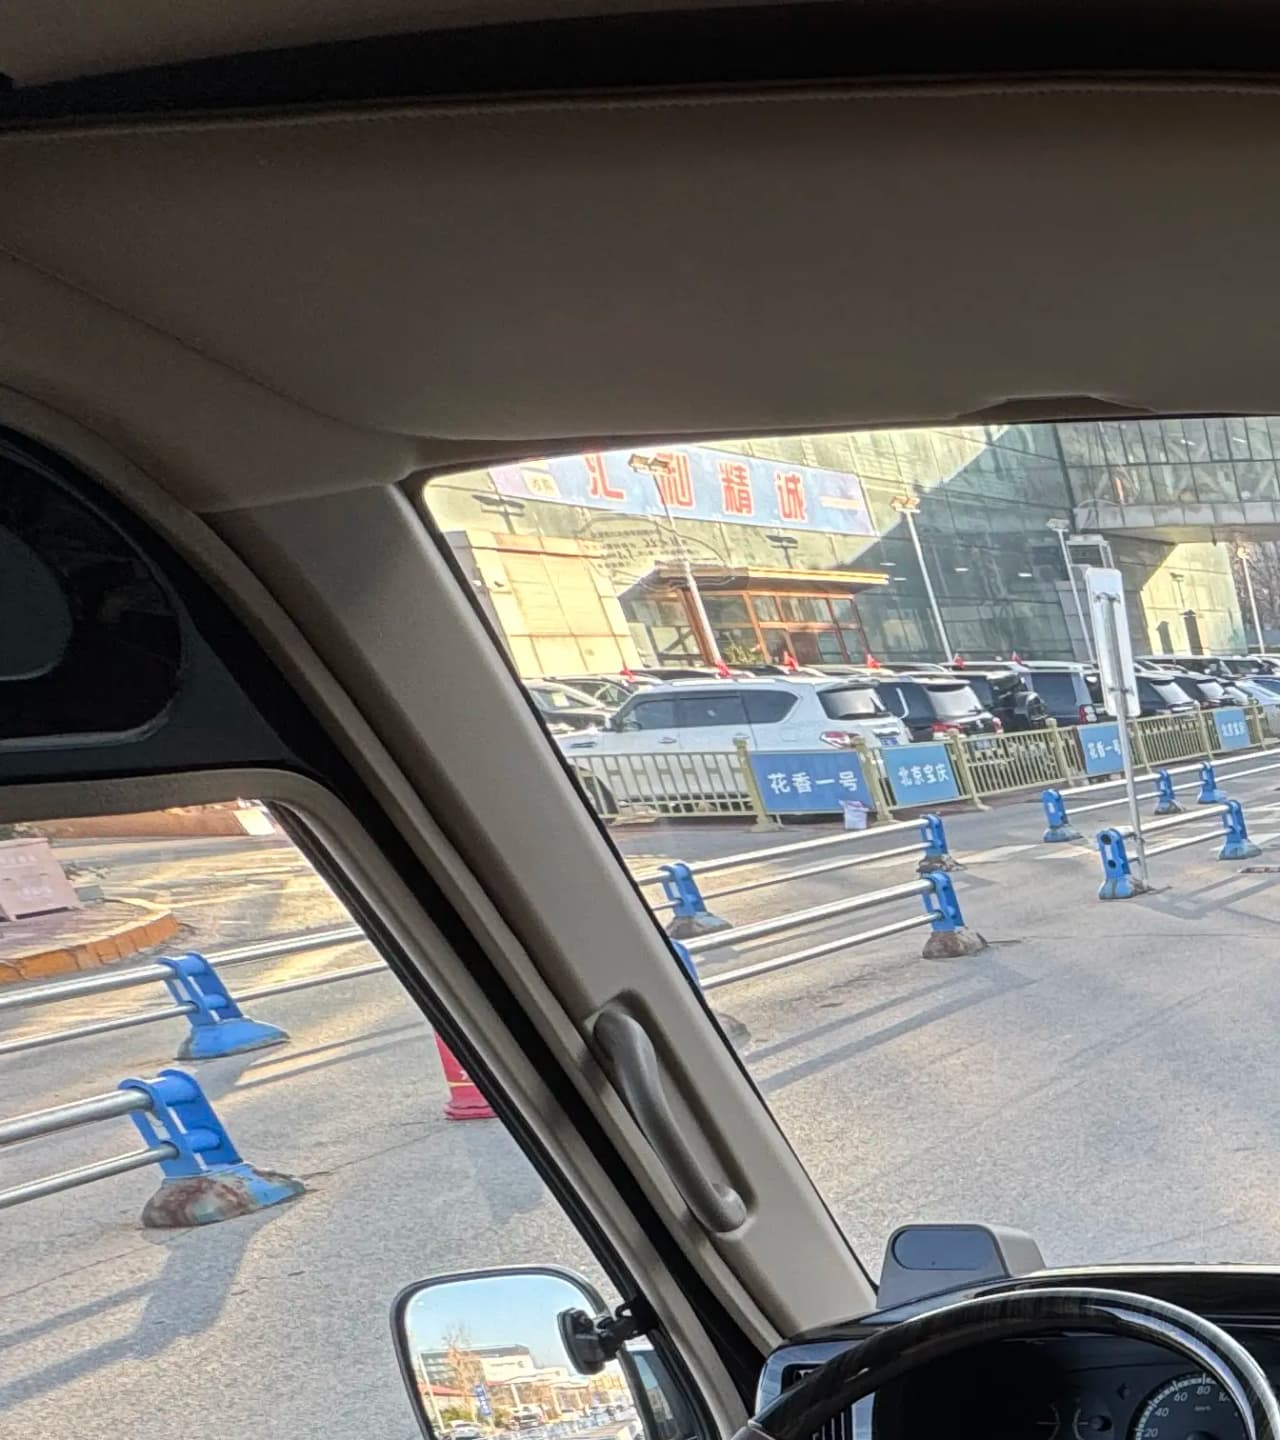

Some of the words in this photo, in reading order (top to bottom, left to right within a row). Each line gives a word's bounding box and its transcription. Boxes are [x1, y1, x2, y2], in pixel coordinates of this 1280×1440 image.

[767, 770, 859, 795] 花香一号
[1196, 1386, 1211, 1395] 80
[1173, 1392, 1188, 1402] 60
[1154, 1407, 1169, 1417] 40
[1143, 1427, 1159, 1438] 20
